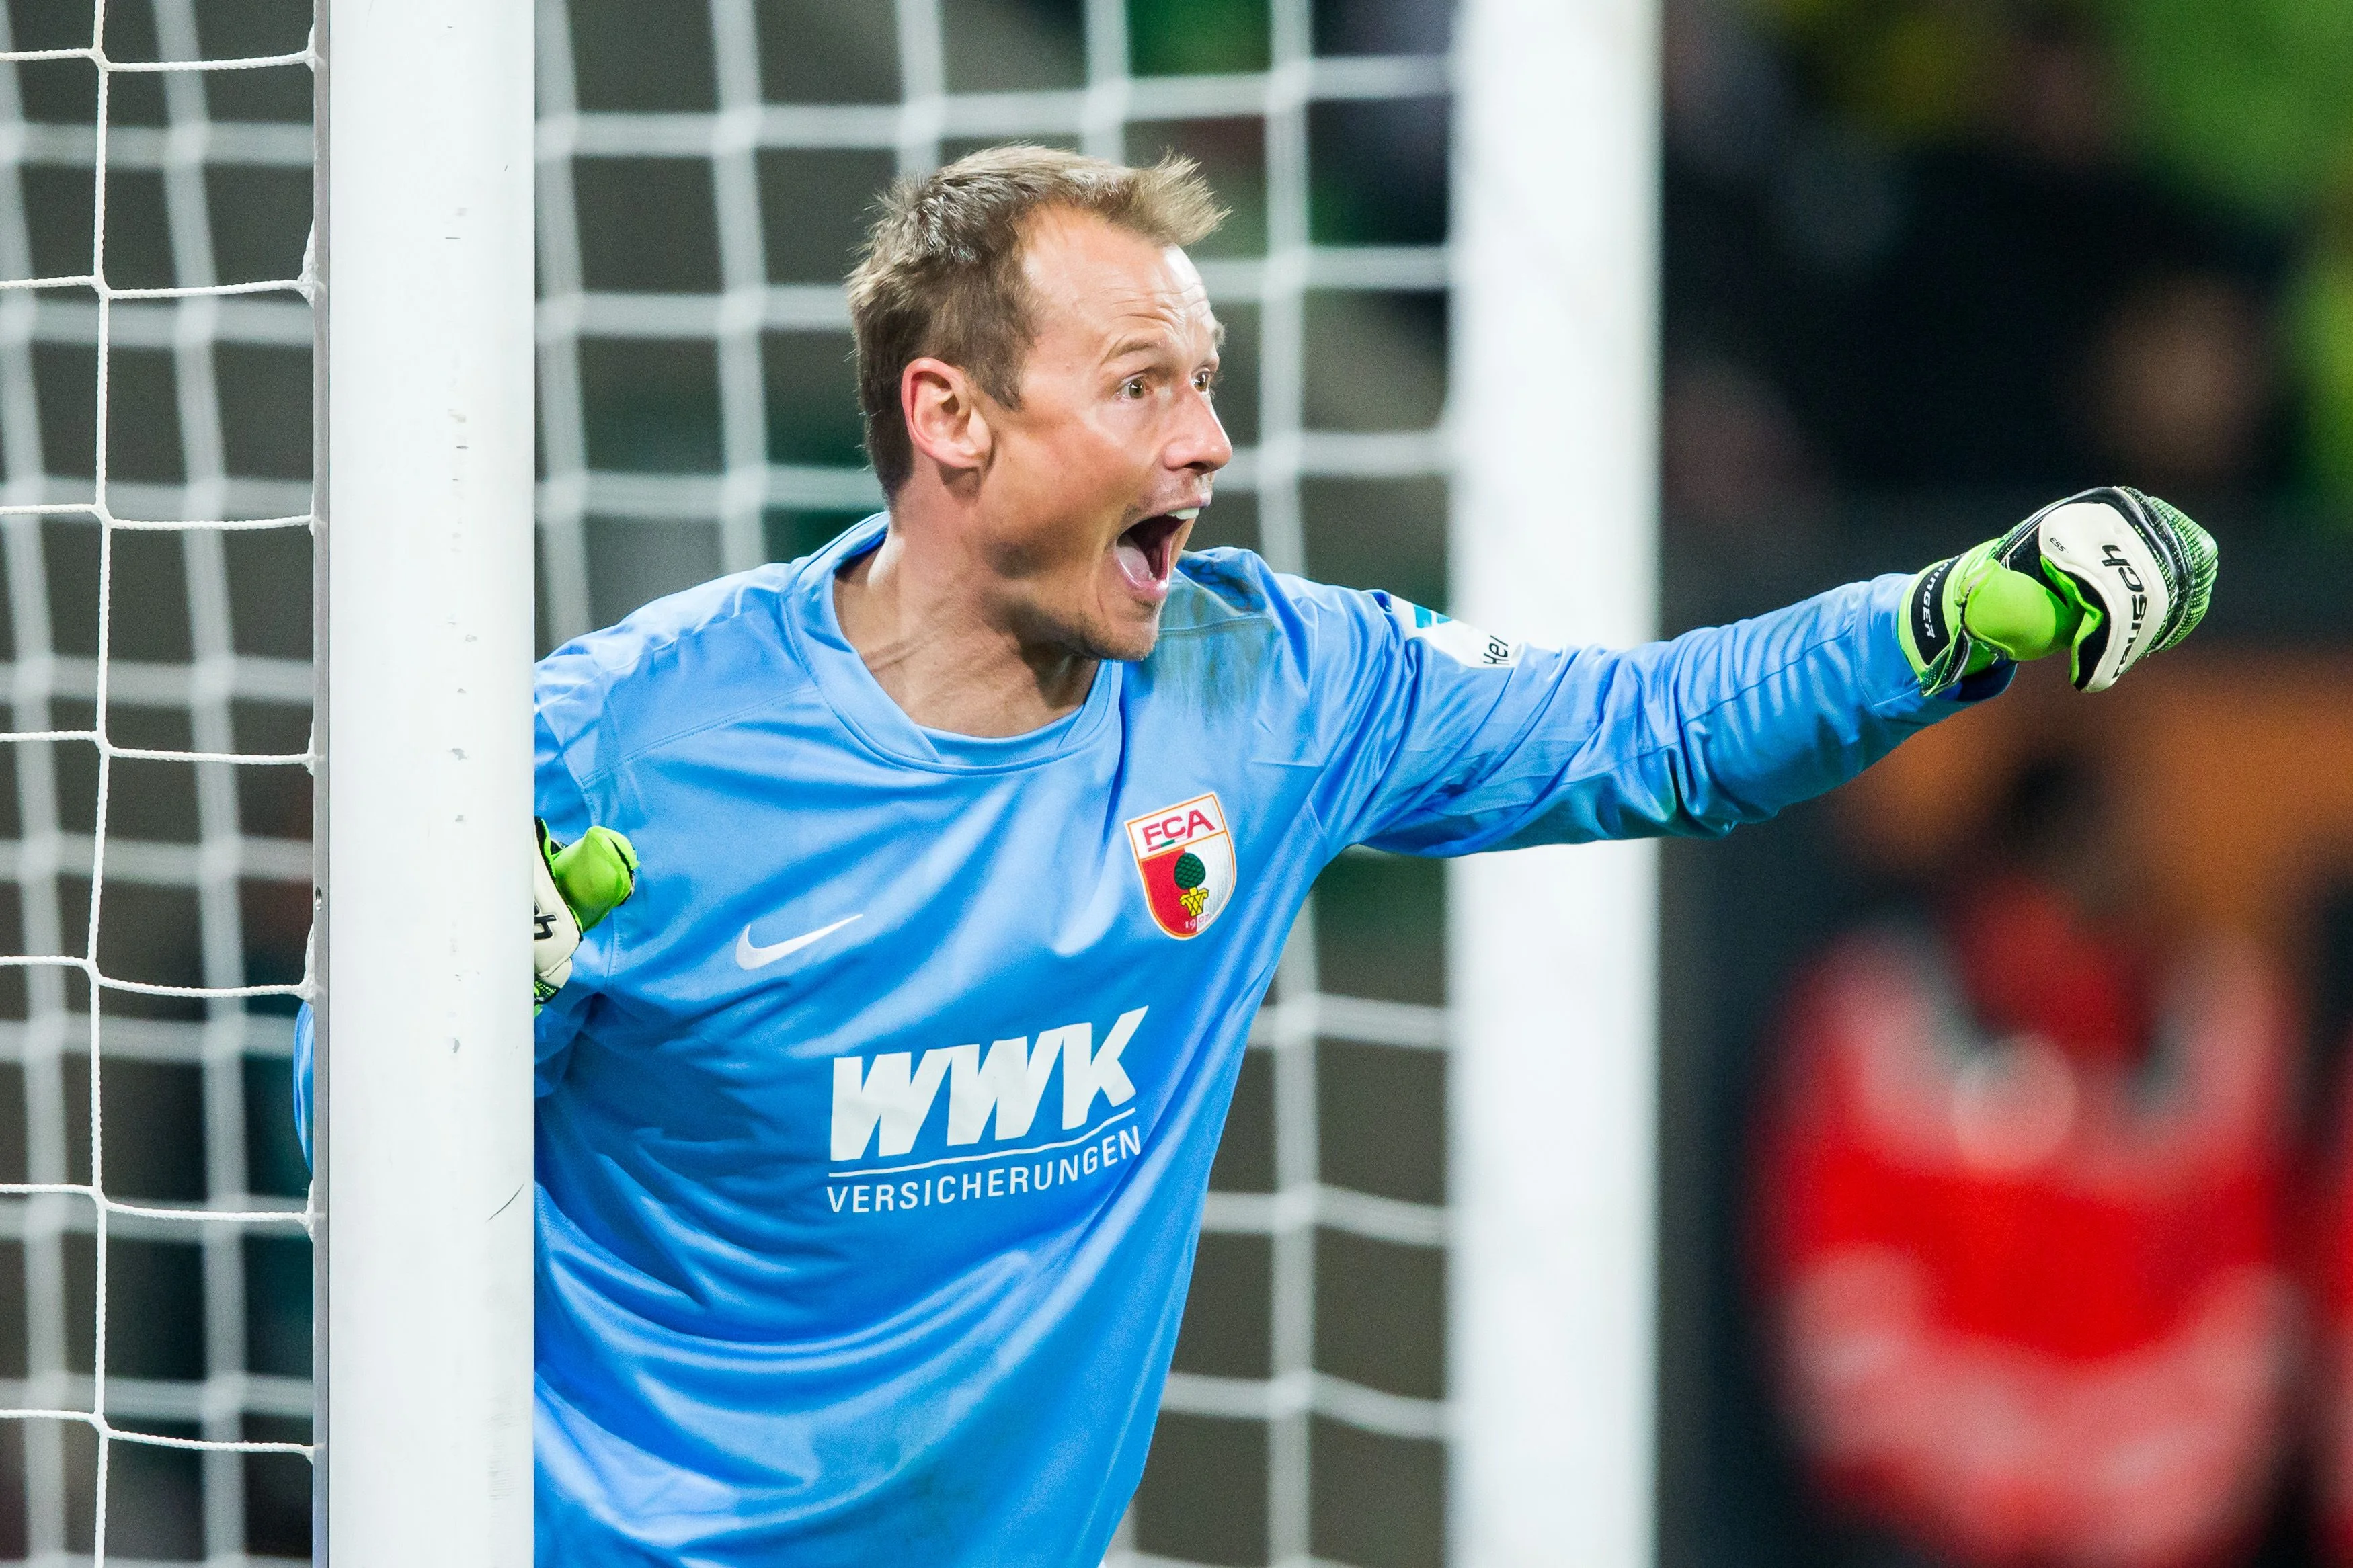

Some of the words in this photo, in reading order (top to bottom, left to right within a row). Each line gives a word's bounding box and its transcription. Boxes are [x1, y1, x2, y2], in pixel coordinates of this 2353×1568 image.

[1142, 809, 1215, 846] FCA
[1185, 913, 1209, 930] 1907
[830, 1005, 1149, 1161] WWK
[826, 1125, 1142, 1213] VERSICHERUNGEN
